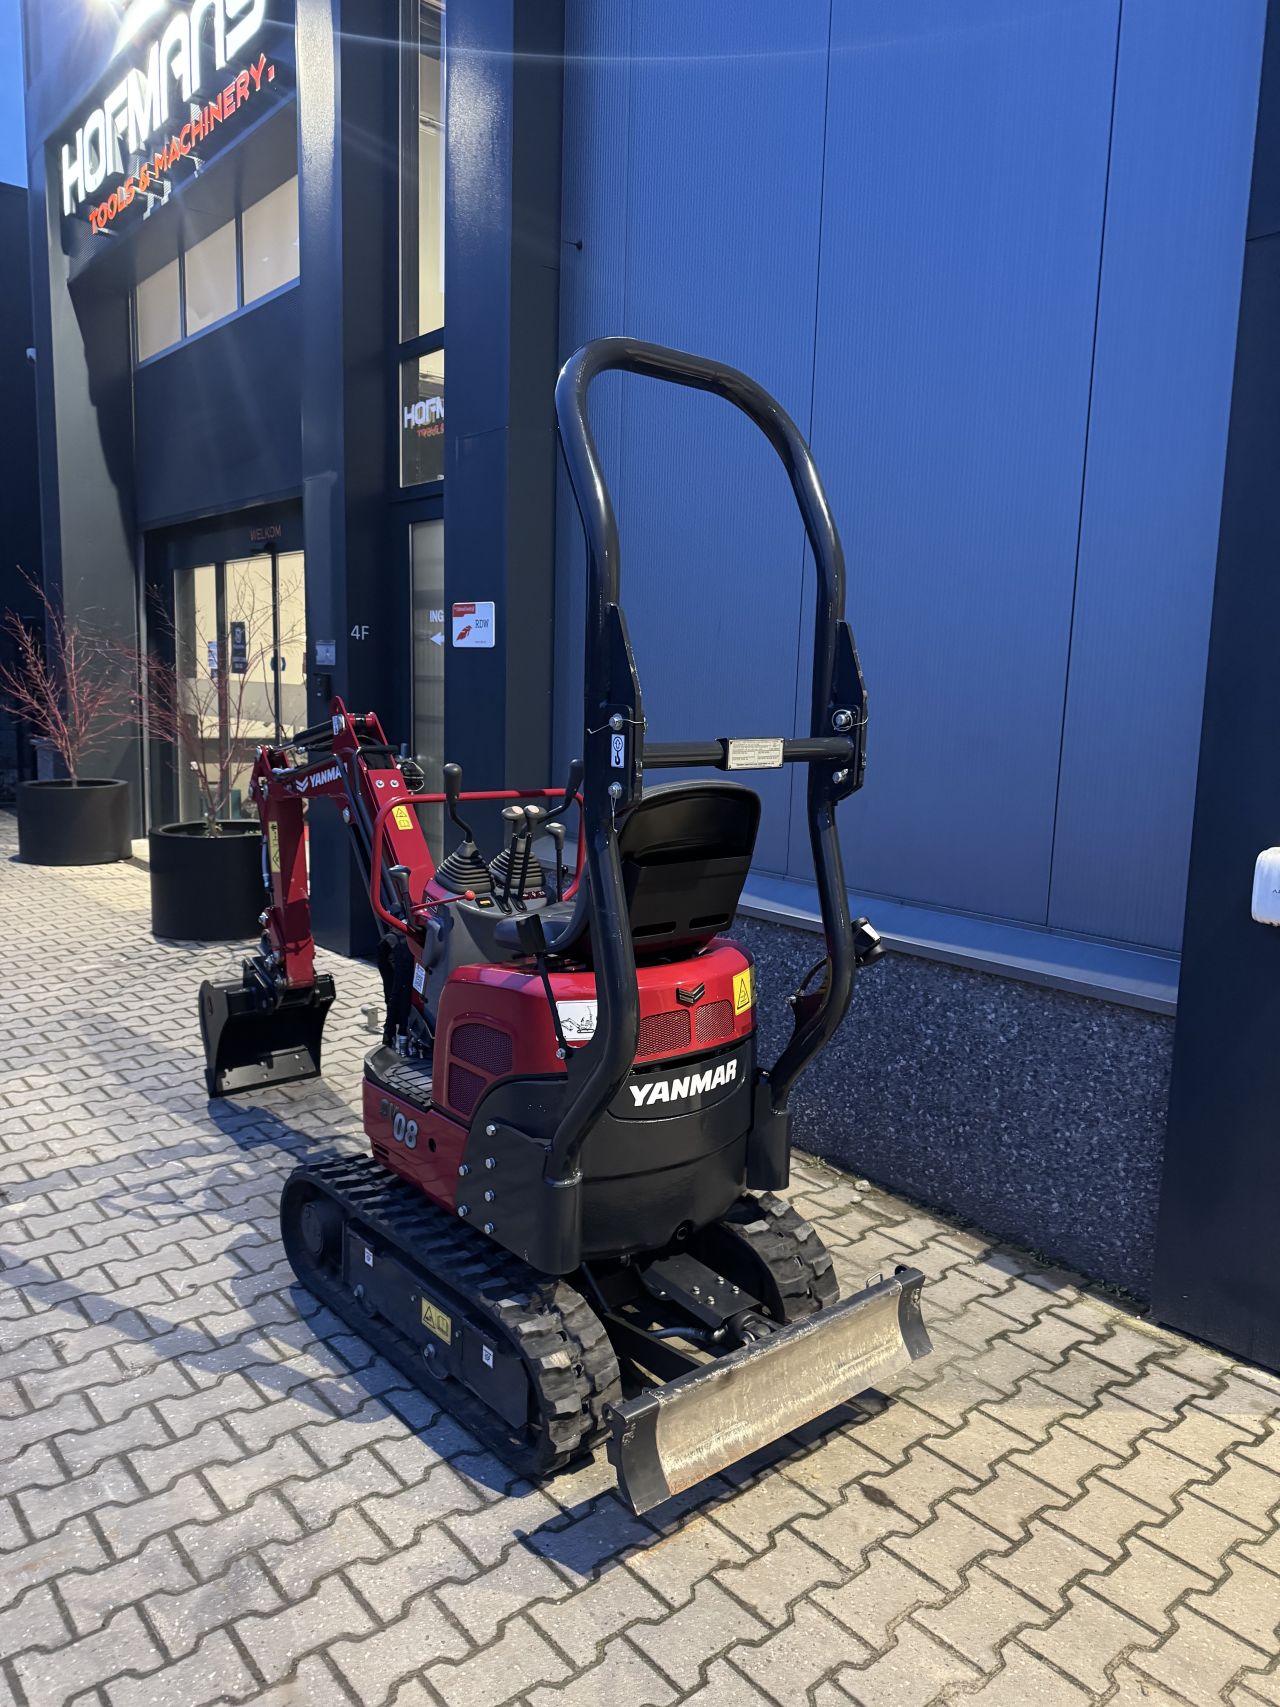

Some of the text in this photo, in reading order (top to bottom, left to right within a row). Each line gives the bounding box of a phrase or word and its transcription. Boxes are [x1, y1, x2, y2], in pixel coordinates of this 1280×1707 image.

[61, 0, 266, 216] HOFMANS
[88, 177, 136, 235] TOOLS
[138, 163, 150, 191] &
[250, 525, 282, 541] WELKOM
[429, 609, 444, 622] ING
[475, 618, 489, 629] RDW
[350, 625, 370, 640] 4F
[629, 1058, 738, 1107] YANMAR
